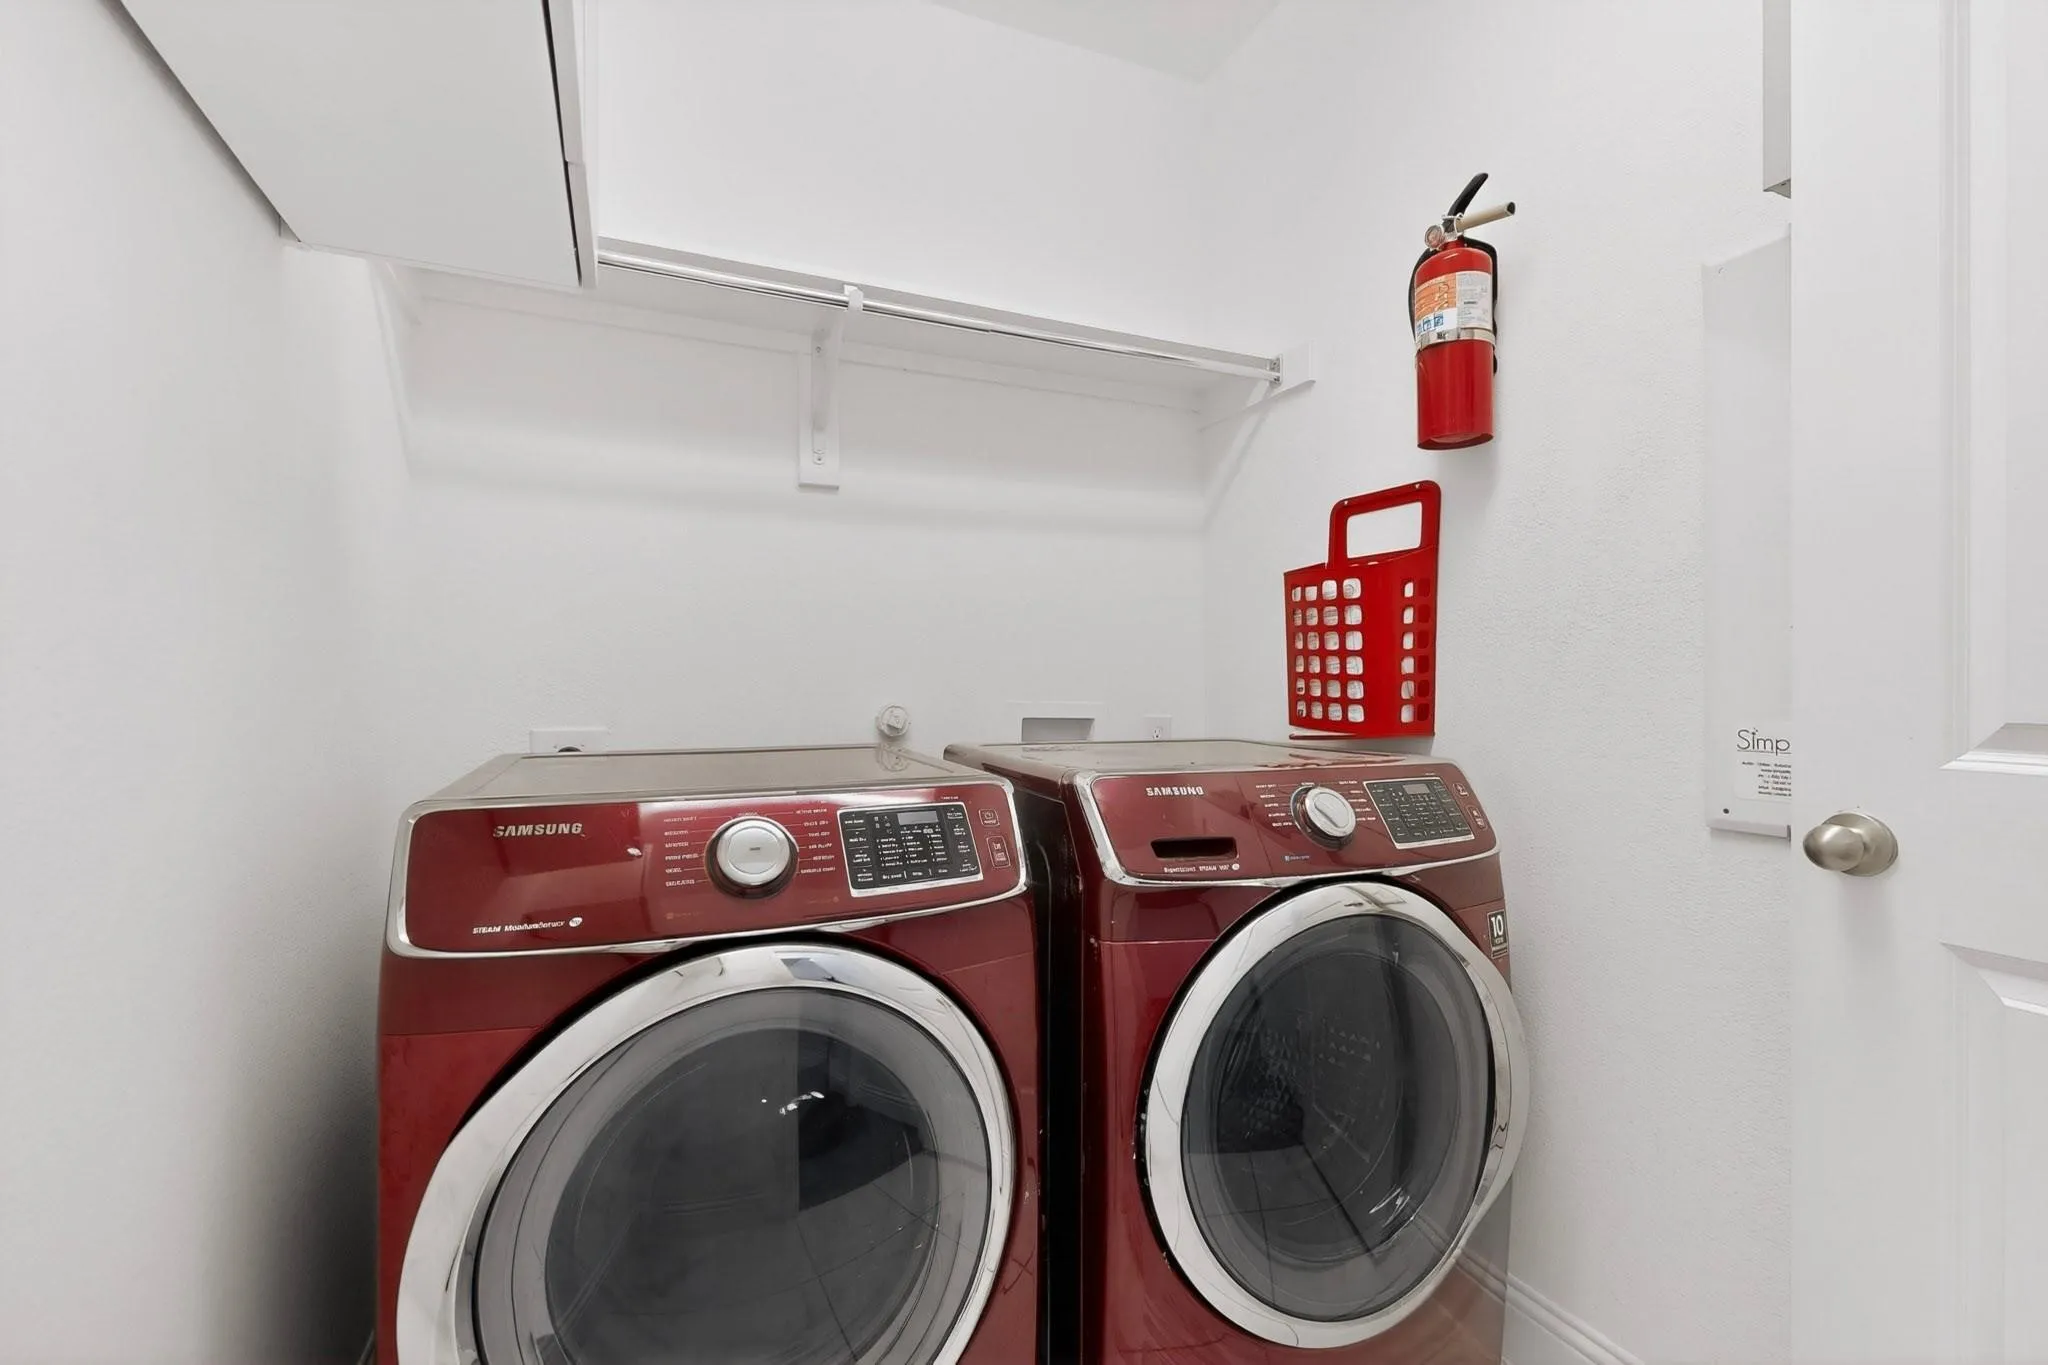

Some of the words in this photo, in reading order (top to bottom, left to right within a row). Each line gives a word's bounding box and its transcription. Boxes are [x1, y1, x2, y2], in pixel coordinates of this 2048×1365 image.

[1145, 786, 1205, 797] SAMSUNG
[493, 822, 583, 838] SAMSUNG
[472, 925, 501, 935] STEAM
[1491, 915, 1504, 938] 10
